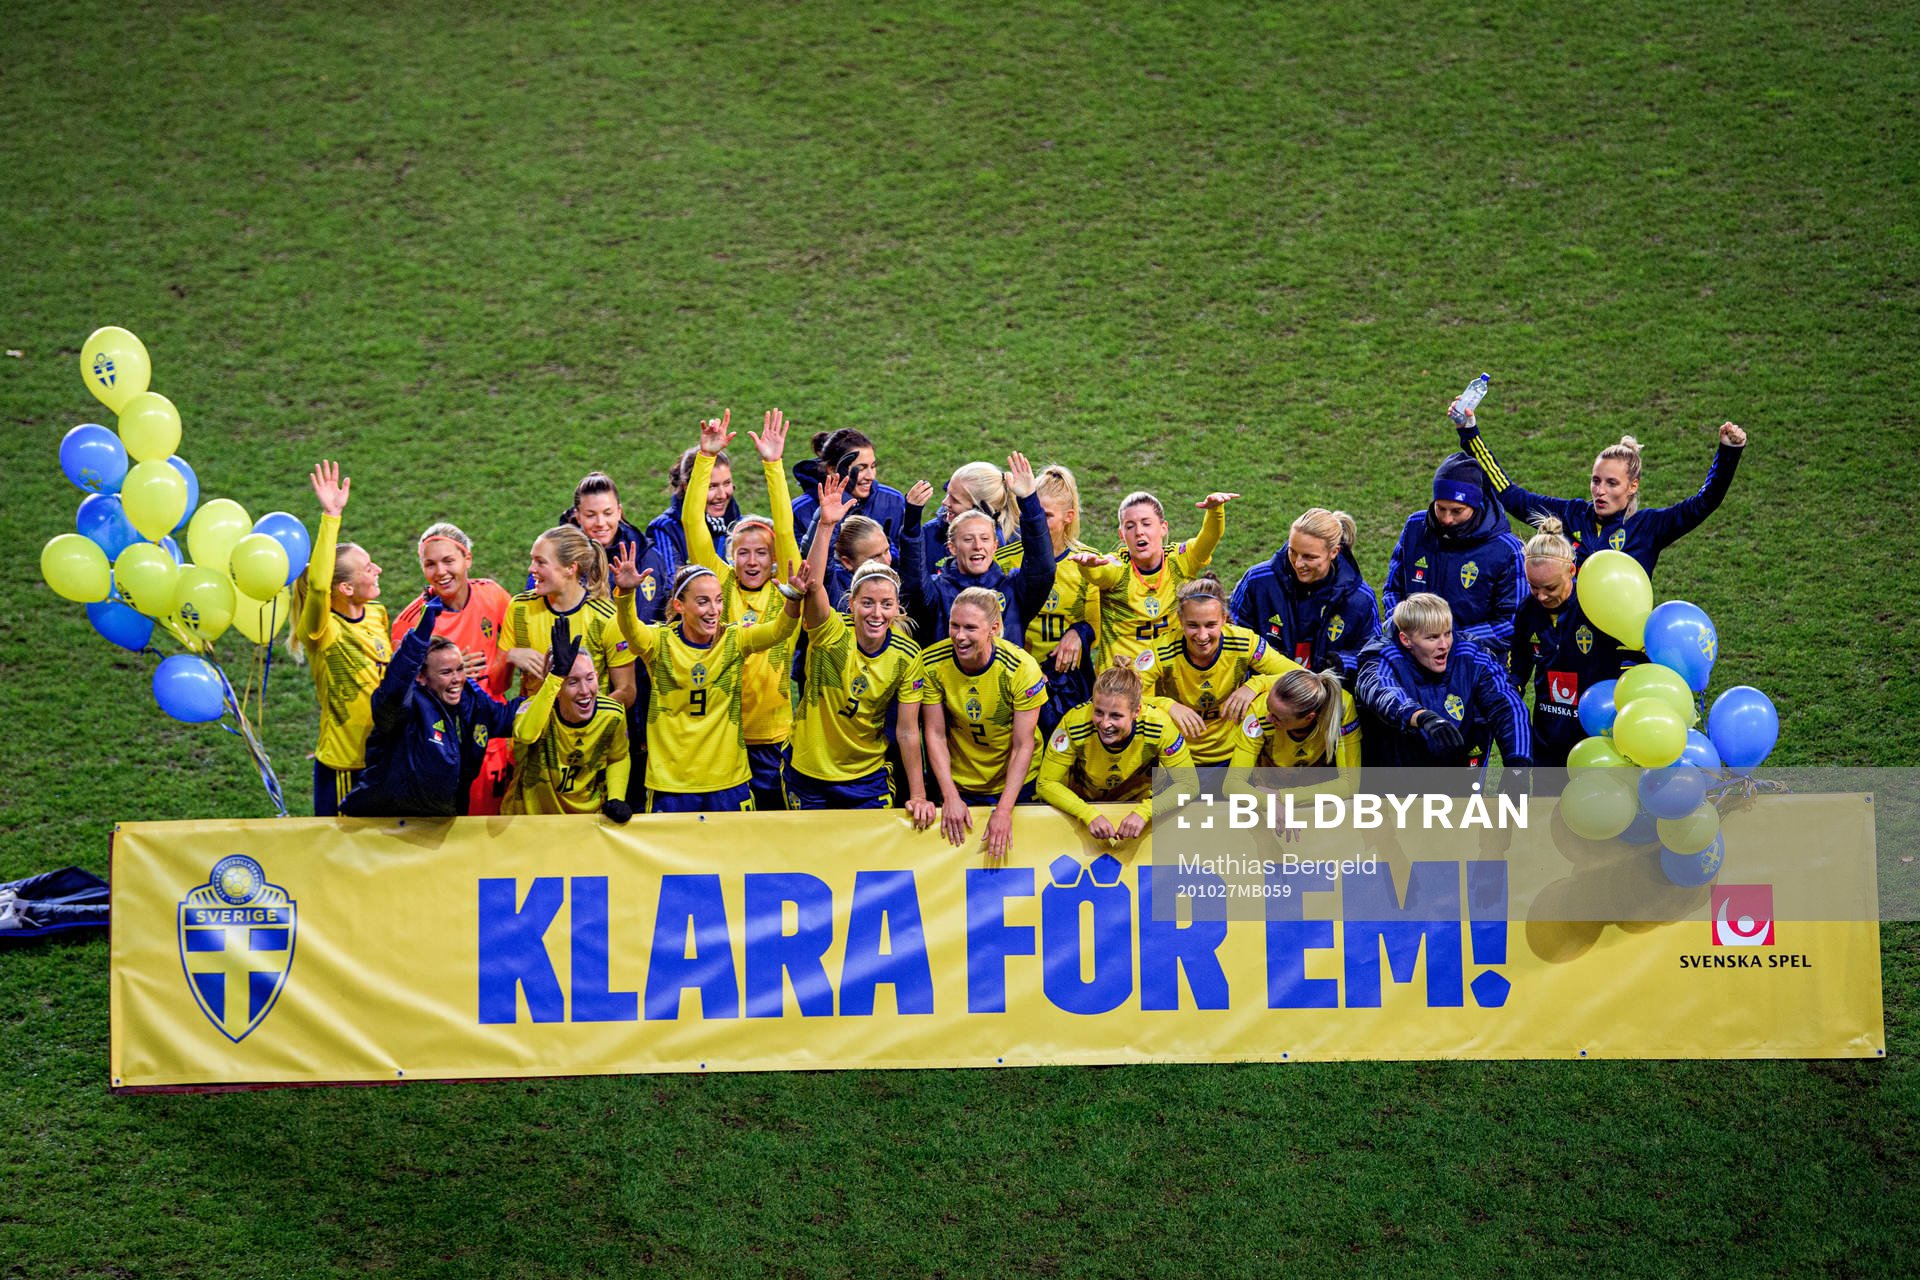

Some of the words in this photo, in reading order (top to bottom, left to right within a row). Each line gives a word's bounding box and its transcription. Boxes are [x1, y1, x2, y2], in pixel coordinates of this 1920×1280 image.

[1038, 614, 1065, 642] 10
[1136, 616, 1168, 640] 22
[690, 689, 706, 716] 9
[1539, 703, 1571, 717] SVENSKA
[969, 723, 989, 746] 2
[196, 910, 278, 923] SVERIGE
[478, 870, 934, 1024] KLARA
[965, 853, 1229, 1015] FÖR
[1265, 860, 1512, 1009] EM!
[1680, 955, 1762, 968] SVENSKA
[1768, 955, 1812, 968] SPEL
